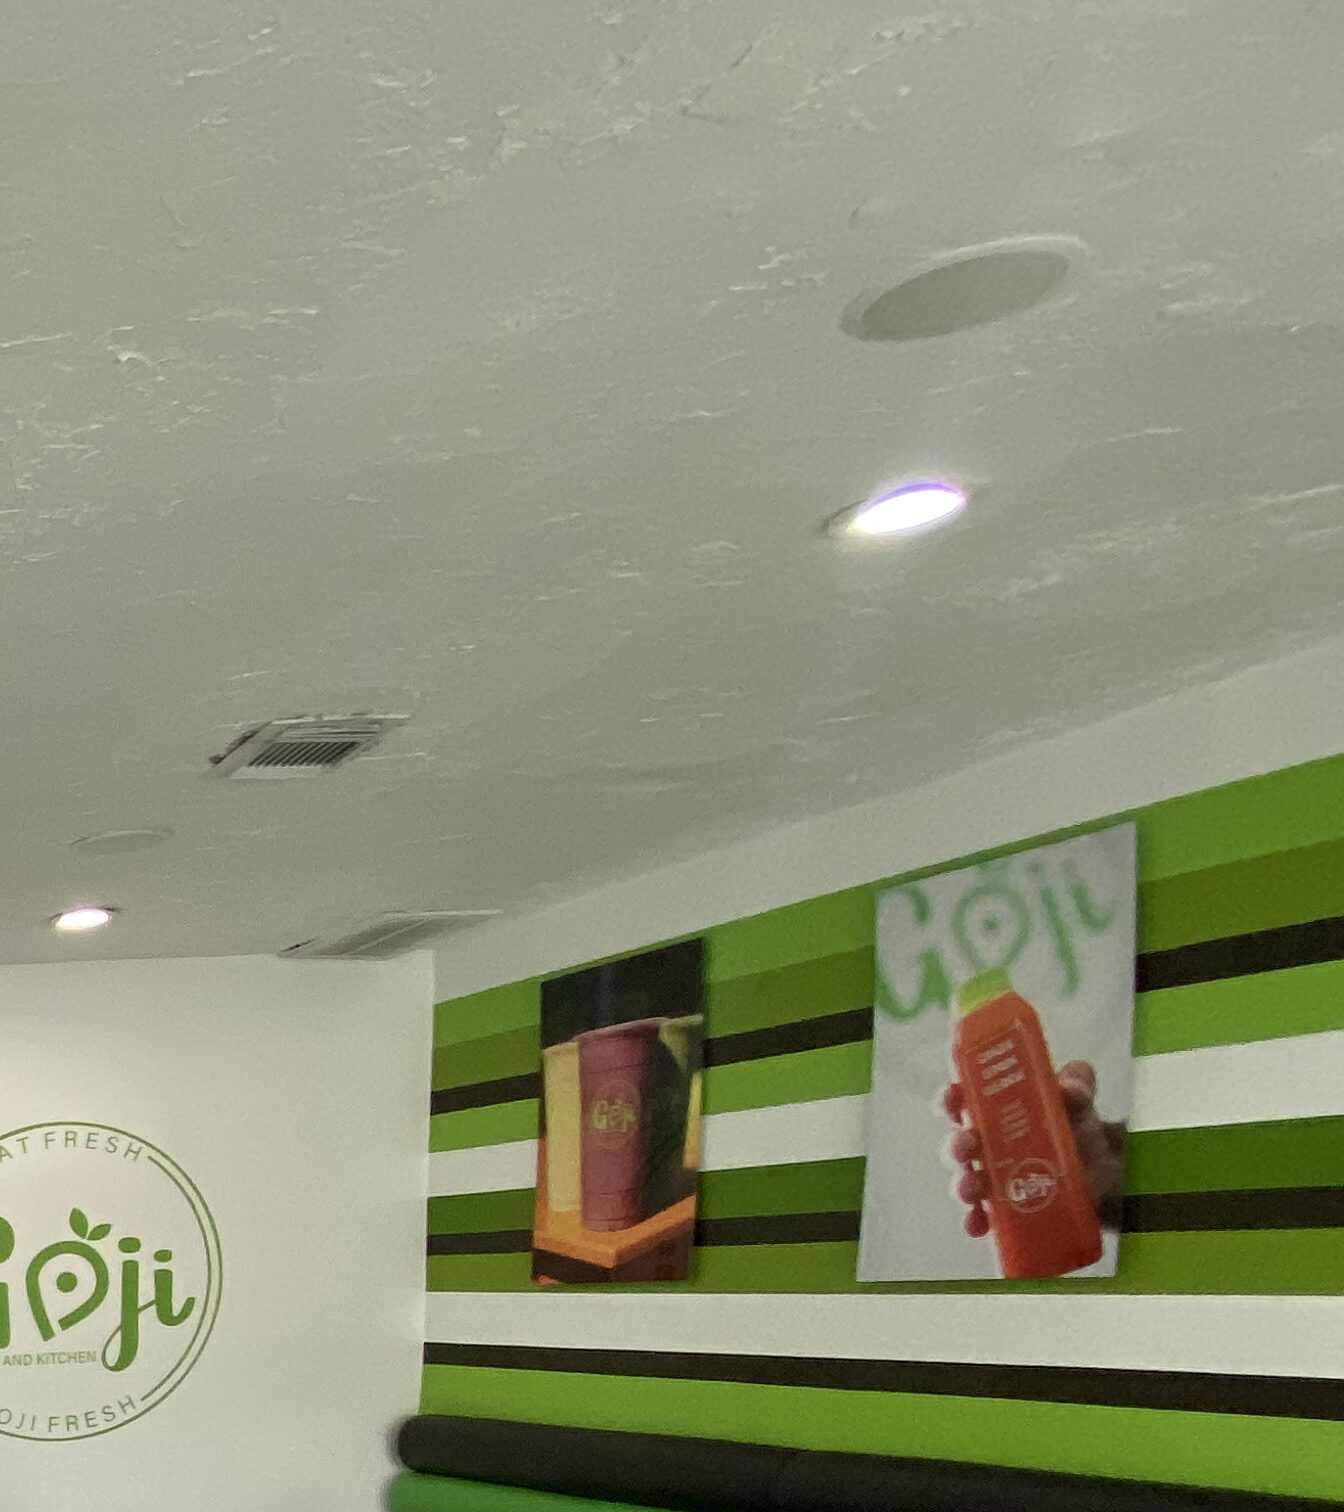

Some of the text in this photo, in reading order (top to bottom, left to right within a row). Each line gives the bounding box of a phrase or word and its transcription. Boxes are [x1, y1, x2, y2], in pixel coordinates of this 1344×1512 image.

[43, 1130, 143, 1162] FRESH
[2, 1353, 33, 1367] AND
[35, 1350, 97, 1365] KITCHEN
[47, 1395, 136, 1432] FRESH
